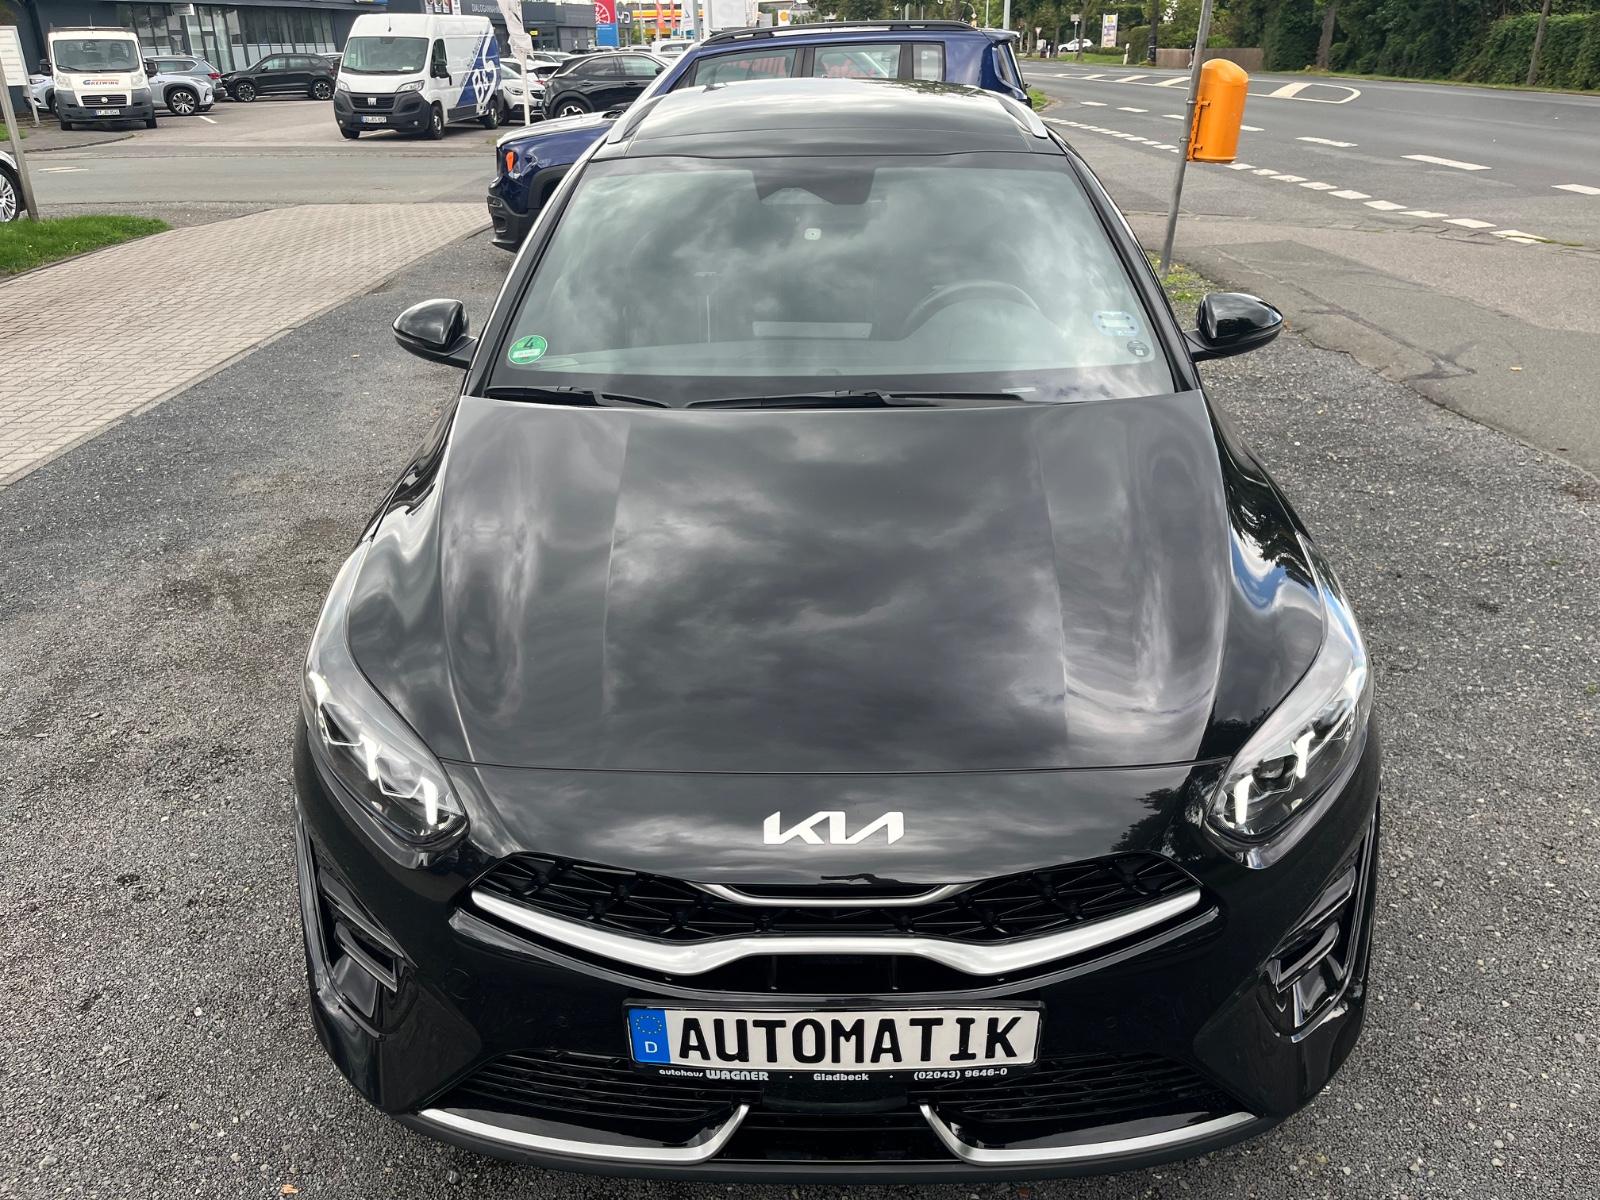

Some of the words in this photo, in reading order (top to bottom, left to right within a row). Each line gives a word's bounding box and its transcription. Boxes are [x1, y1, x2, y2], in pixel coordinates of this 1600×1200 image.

[523, 337, 534, 349] 4
[763, 811, 905, 845] KIA
[644, 1041, 658, 1054] D
[678, 1016, 1022, 1064] AUTOMATIK
[659, 1069, 704, 1077] autohaus
[705, 1069, 770, 1081] WAGNER
[813, 1073, 870, 1081] Gladbeck
[913, 1070, 961, 1081] (02043)
[964, 1067, 1008, 1078] 9646-0
